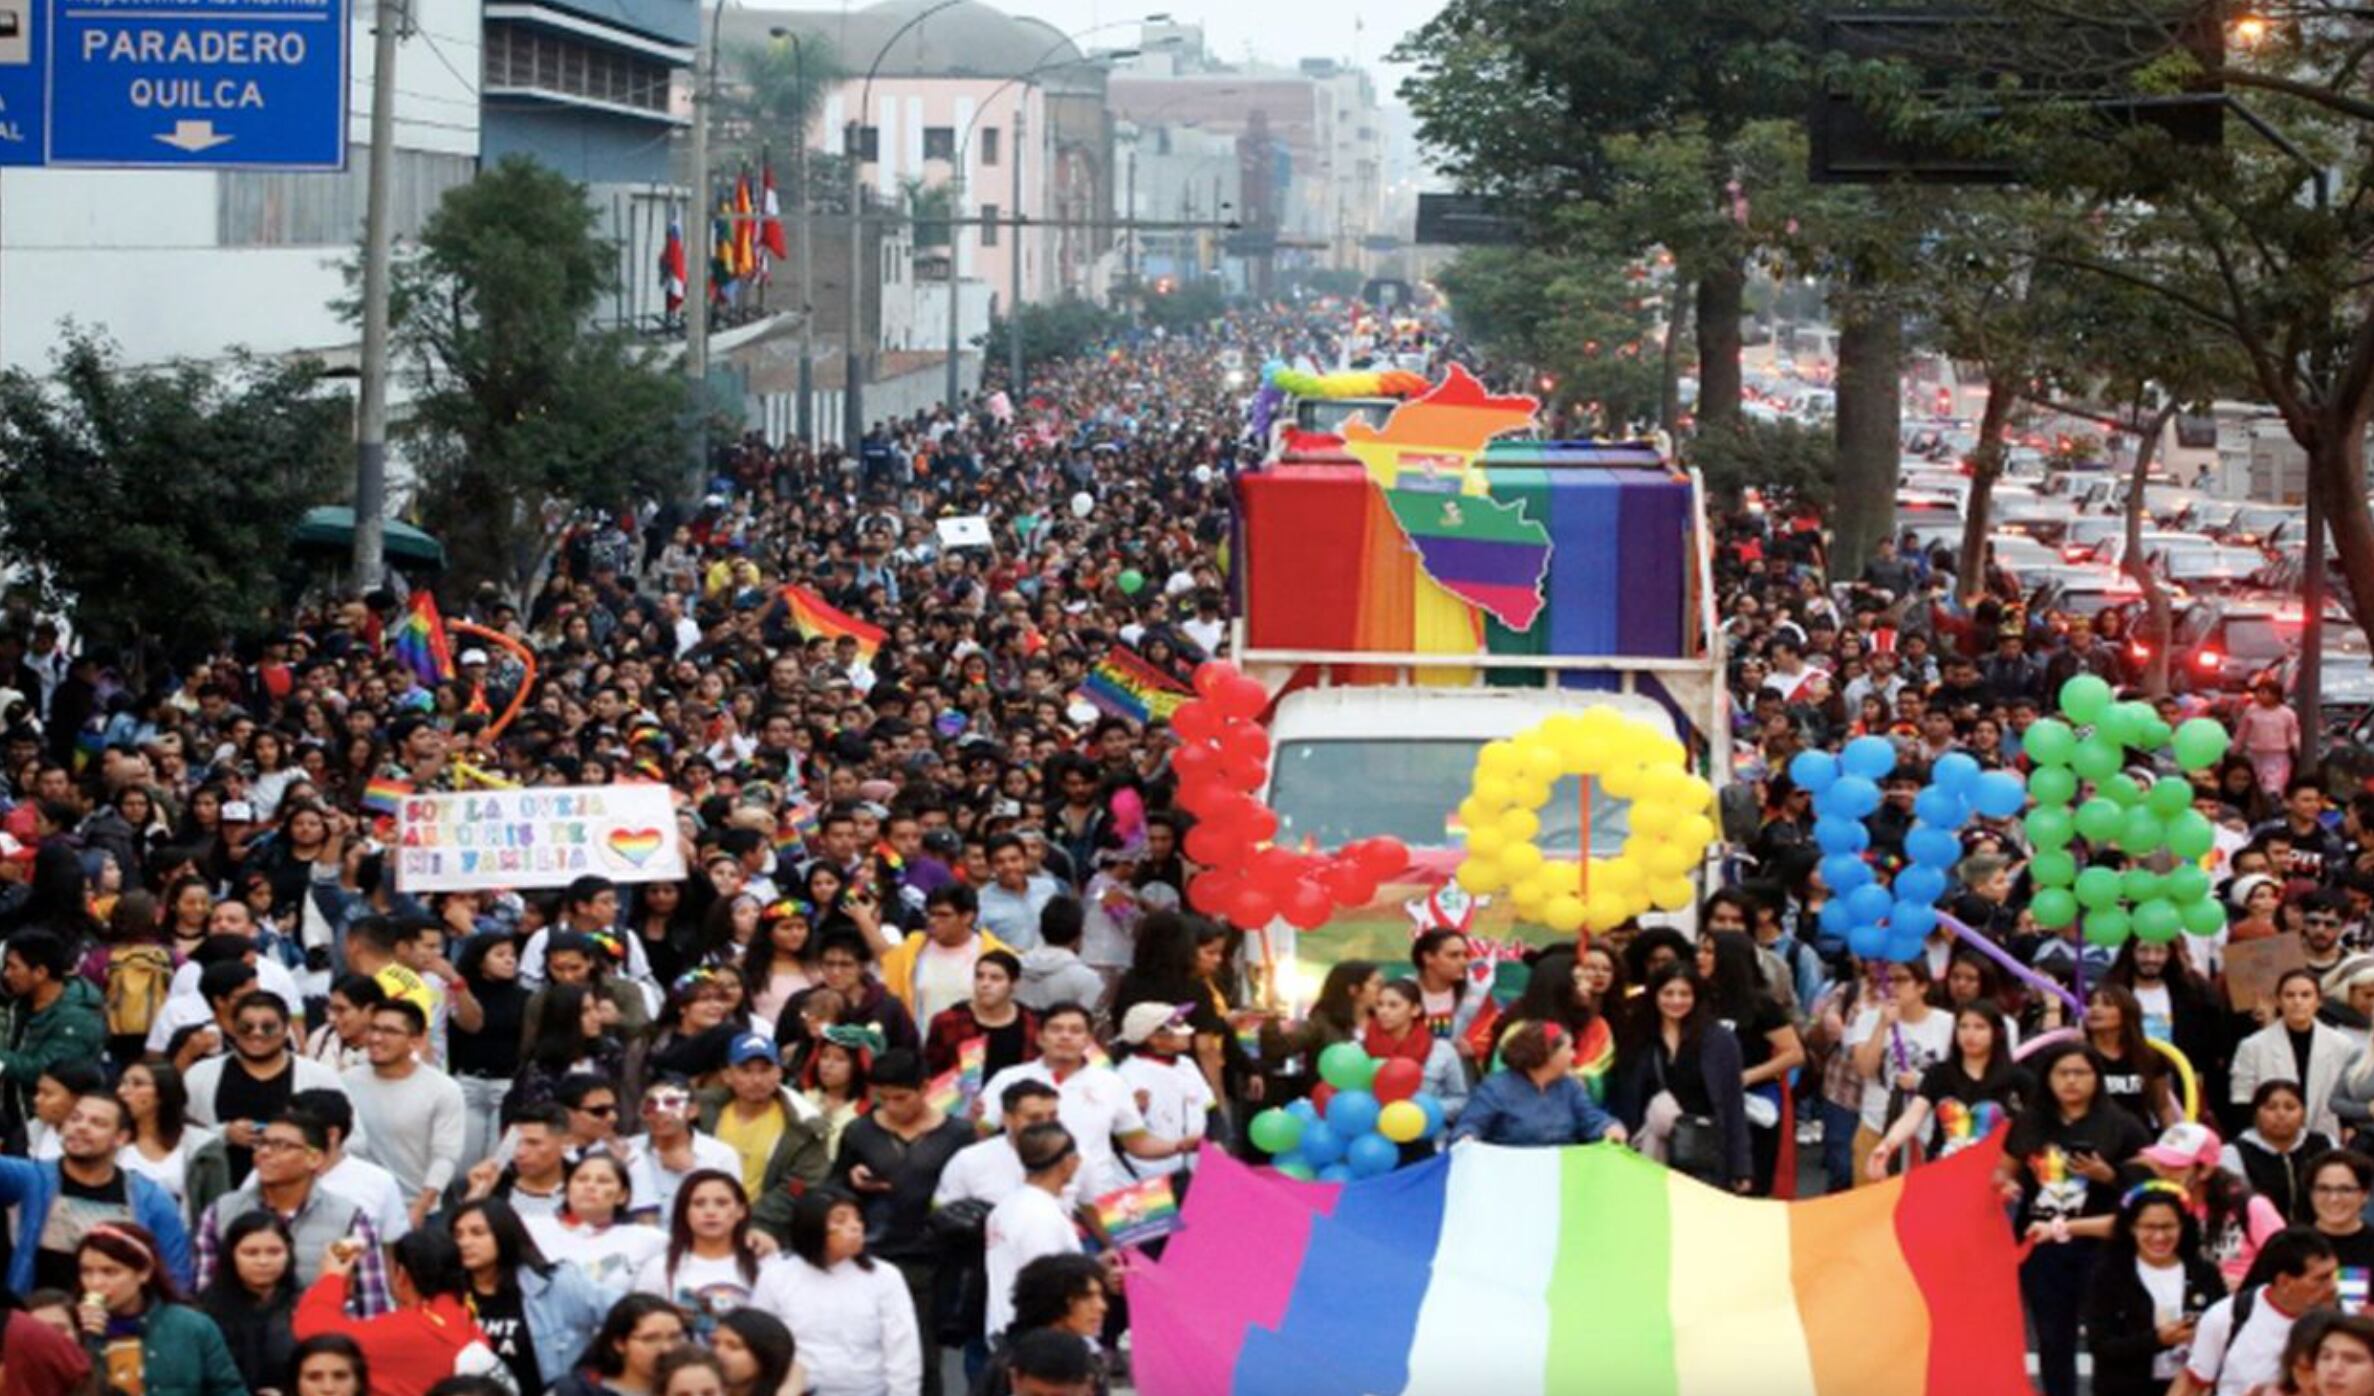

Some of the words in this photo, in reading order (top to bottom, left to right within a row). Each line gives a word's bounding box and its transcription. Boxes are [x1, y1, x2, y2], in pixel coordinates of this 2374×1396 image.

[83, 30, 305, 63] PARADERO
[130, 78, 264, 109] QUILCA
[406, 799, 453, 822] SOY
[465, 796, 502, 822] LA
[520, 794, 606, 817] OVEJA
[550, 821, 587, 844] DE
[406, 850, 442, 876] MI
[460, 847, 588, 873] FAMILIA
